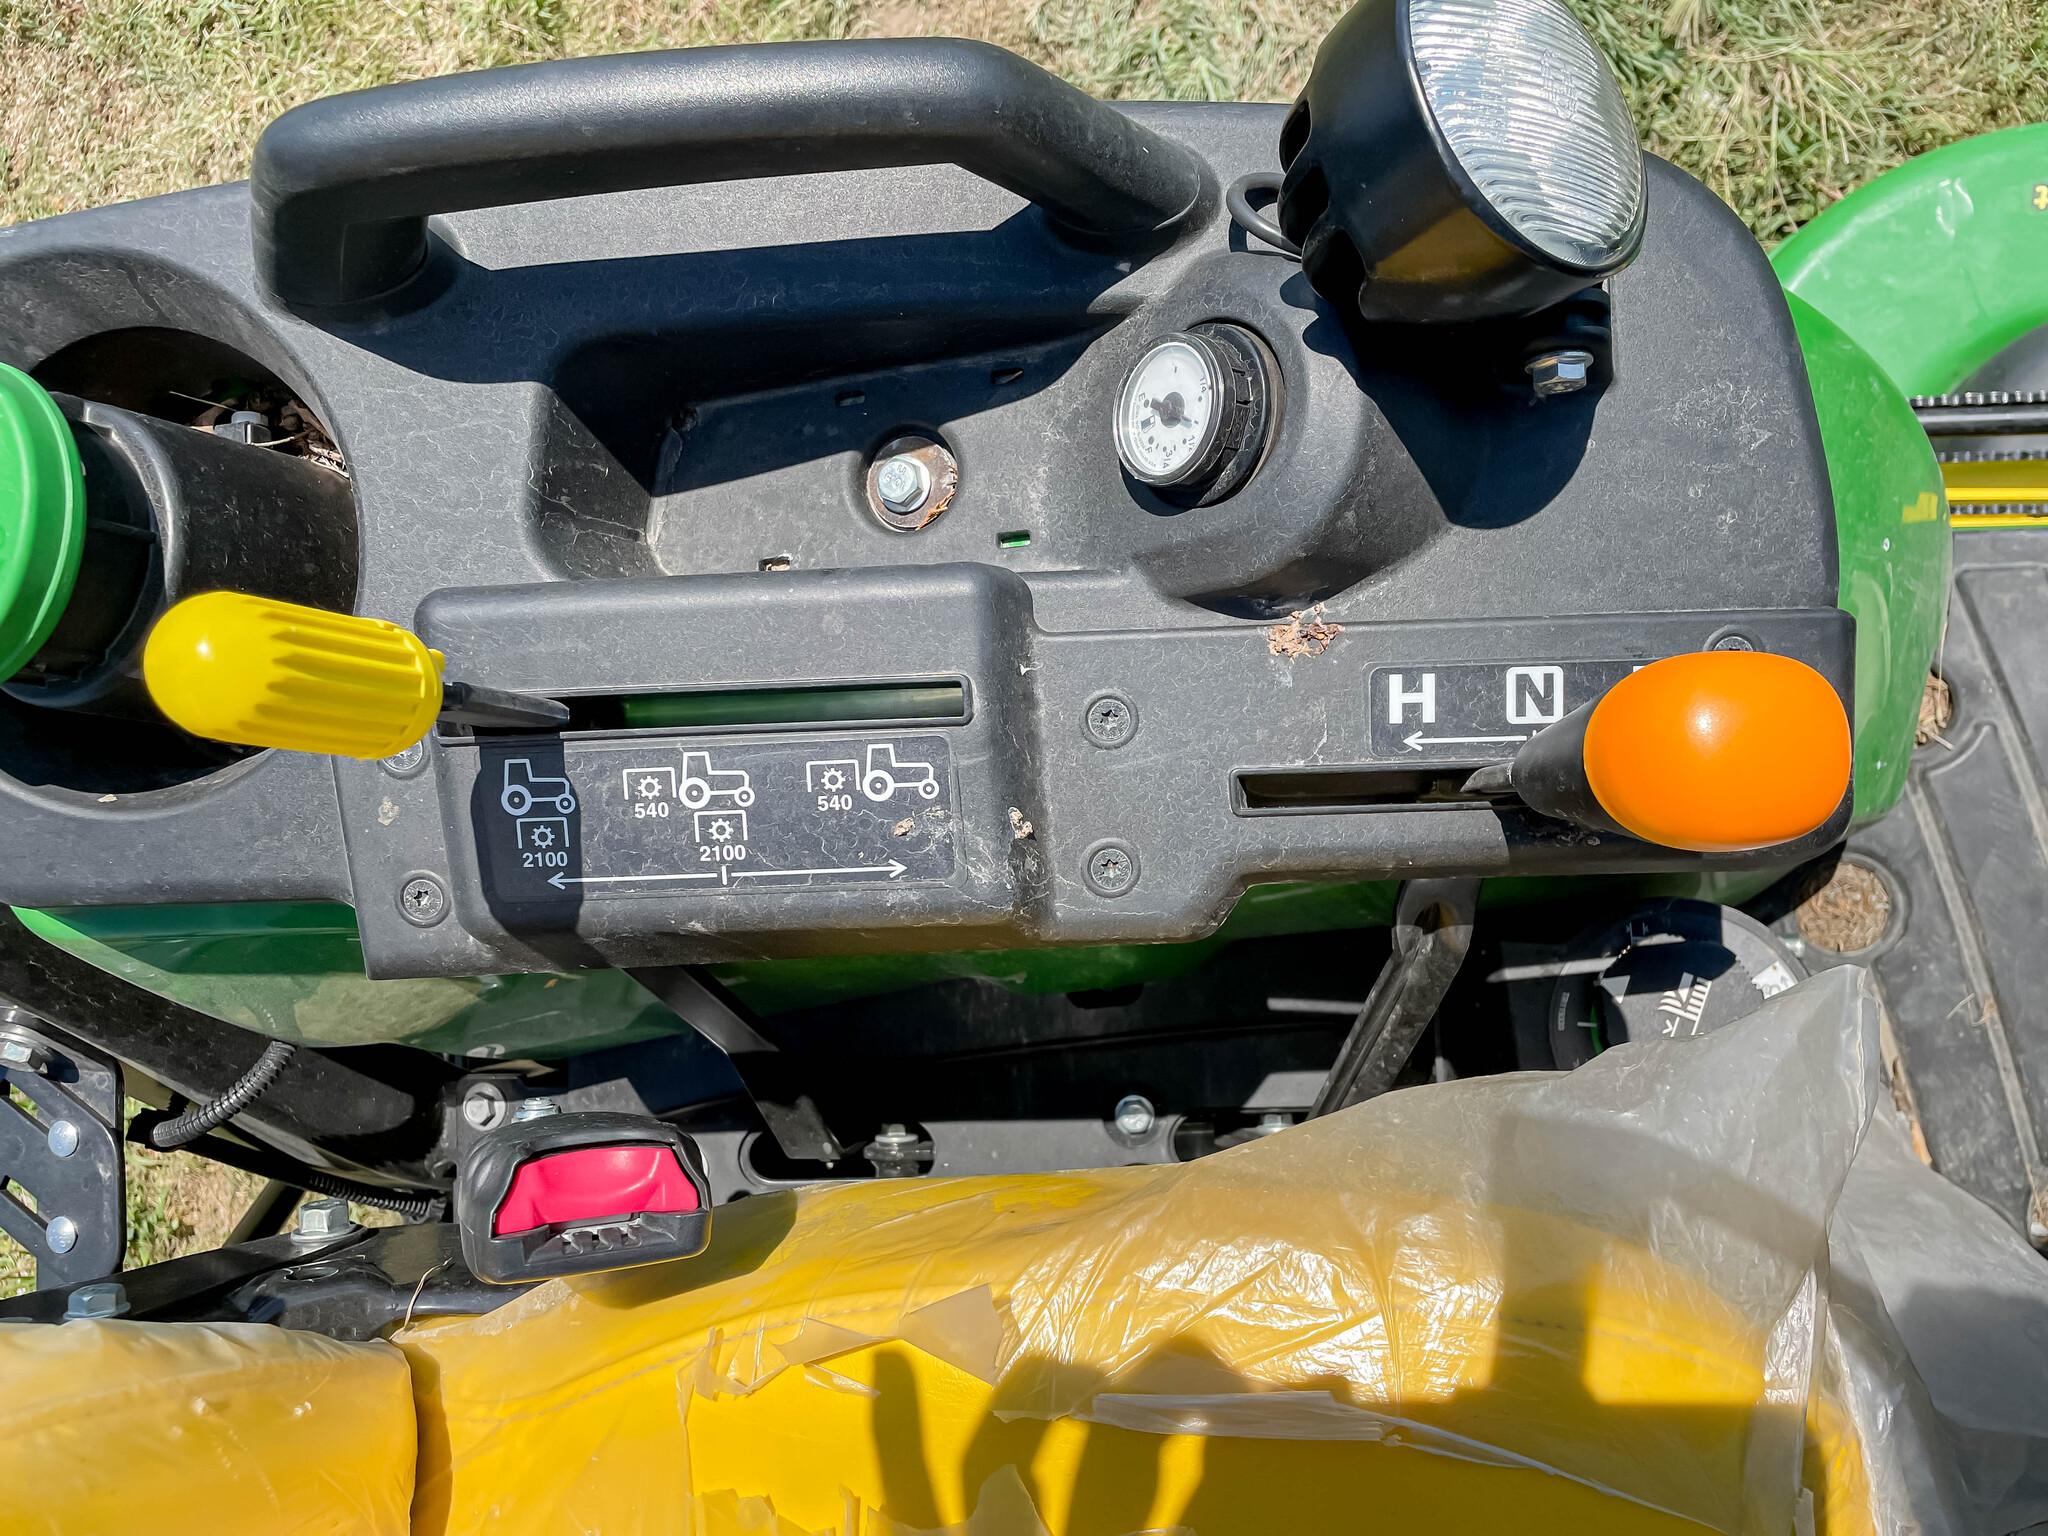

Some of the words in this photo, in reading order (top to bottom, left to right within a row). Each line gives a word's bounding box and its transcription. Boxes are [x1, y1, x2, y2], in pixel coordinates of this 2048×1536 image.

[1139, 392, 1146, 402] E
[1388, 673, 1436, 725] H
[1515, 672, 1555, 718] N
[633, 801, 670, 819] 540
[816, 794, 854, 812] 540
[521, 851, 569, 868] 2100
[699, 844, 747, 862] 2100
